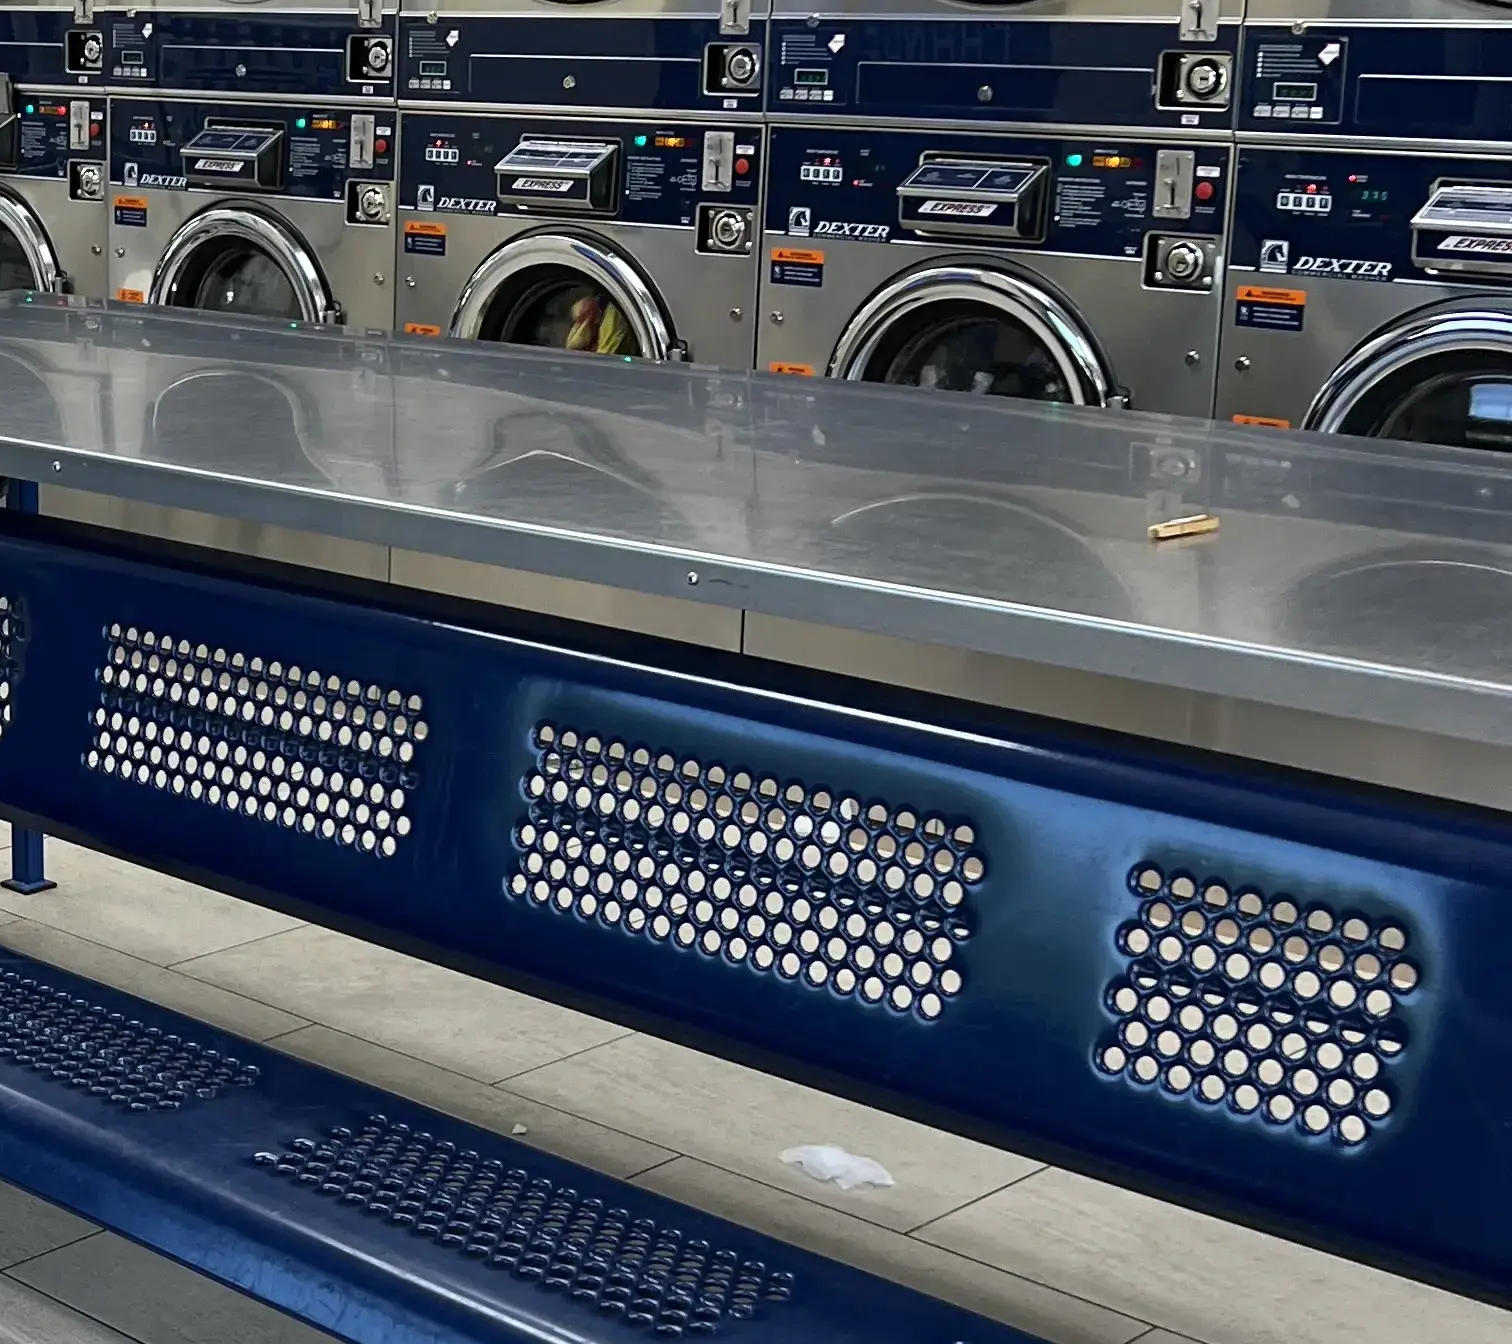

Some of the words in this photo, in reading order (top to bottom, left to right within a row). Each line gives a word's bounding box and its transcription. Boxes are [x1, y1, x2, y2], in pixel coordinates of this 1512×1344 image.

[139, 173, 188, 187] DEXTER
[521, 178, 564, 190] EXPRESS
[437, 197, 497, 212] DEXTER
[929, 201, 983, 214] EXPRESS
[813, 221, 890, 238] DEXTER
[1292, 256, 1393, 276] DEXTER
